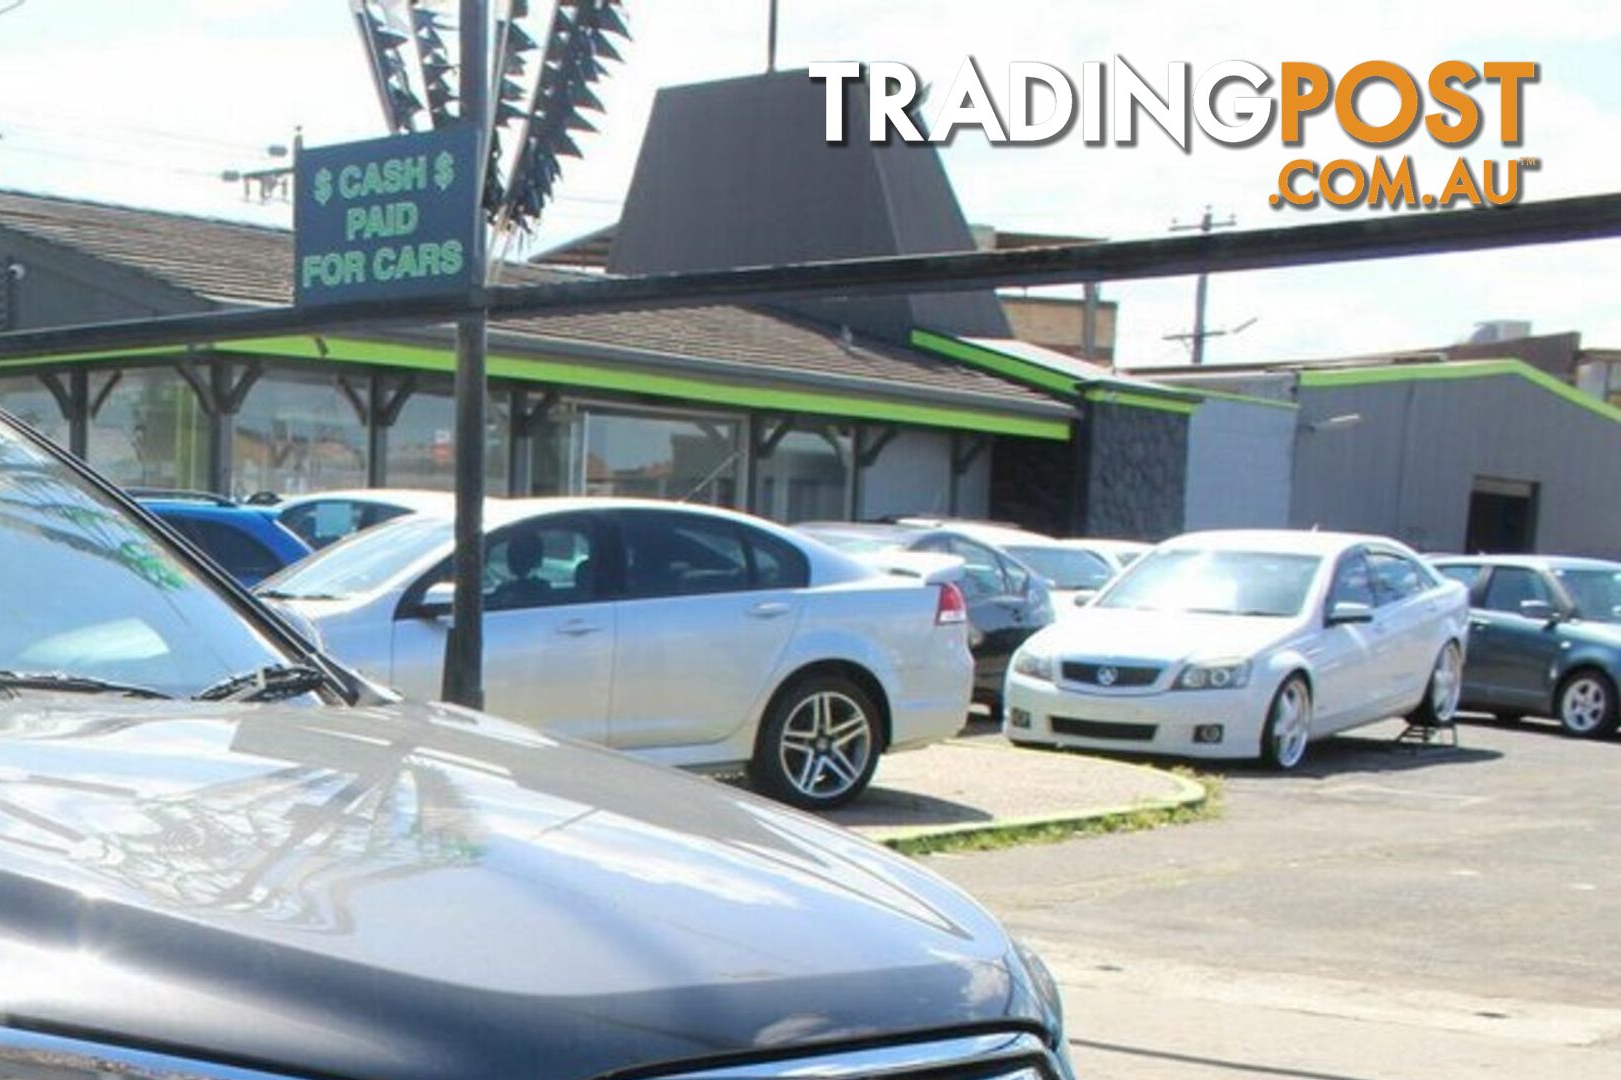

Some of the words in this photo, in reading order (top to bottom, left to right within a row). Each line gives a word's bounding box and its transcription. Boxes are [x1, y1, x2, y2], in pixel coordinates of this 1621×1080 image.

[338, 156, 427, 199] CASH
[346, 202, 418, 241] PAID
[302, 251, 366, 288] FOR
[373, 240, 463, 281] CARS
